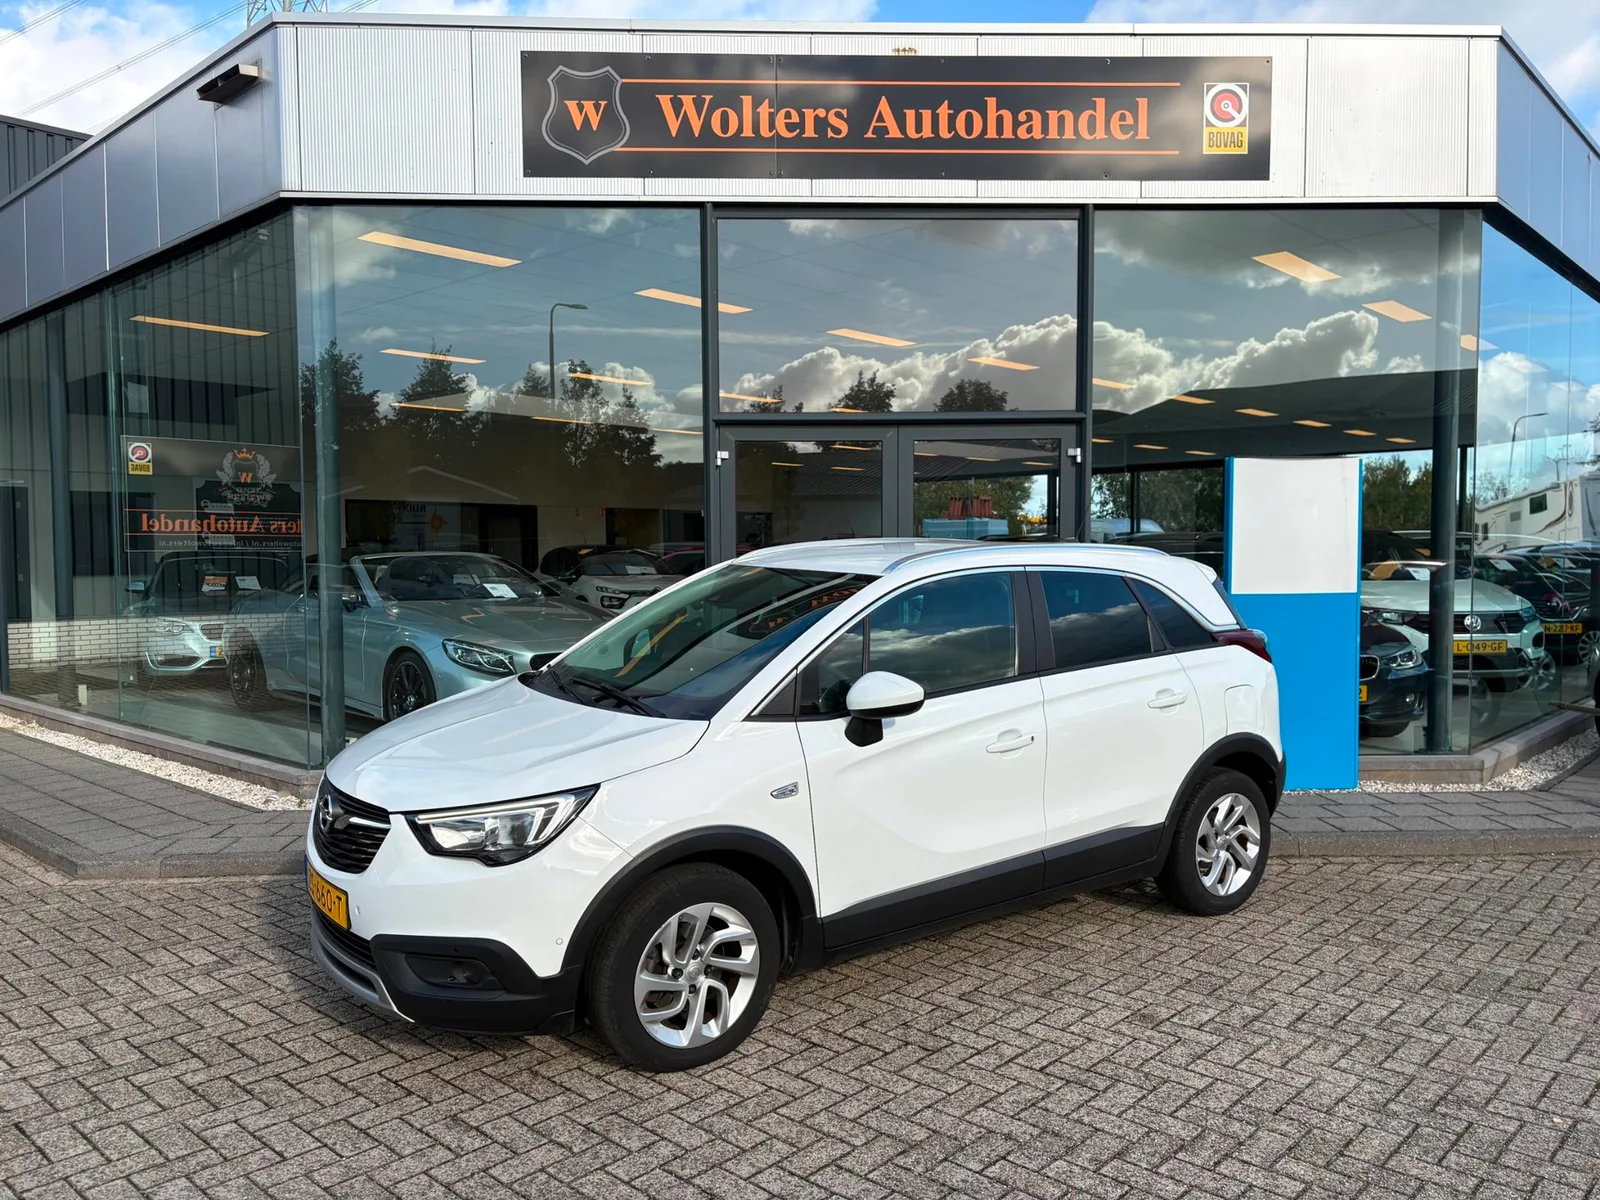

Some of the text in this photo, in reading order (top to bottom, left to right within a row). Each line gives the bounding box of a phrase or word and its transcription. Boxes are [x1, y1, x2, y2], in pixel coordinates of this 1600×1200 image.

[565, 100, 607, 131] W
[656, 94, 1150, 141] Wolters Autohandel
[1208, 131, 1244, 149] BOVAG
[308, 867, 343, 920] -660-T
